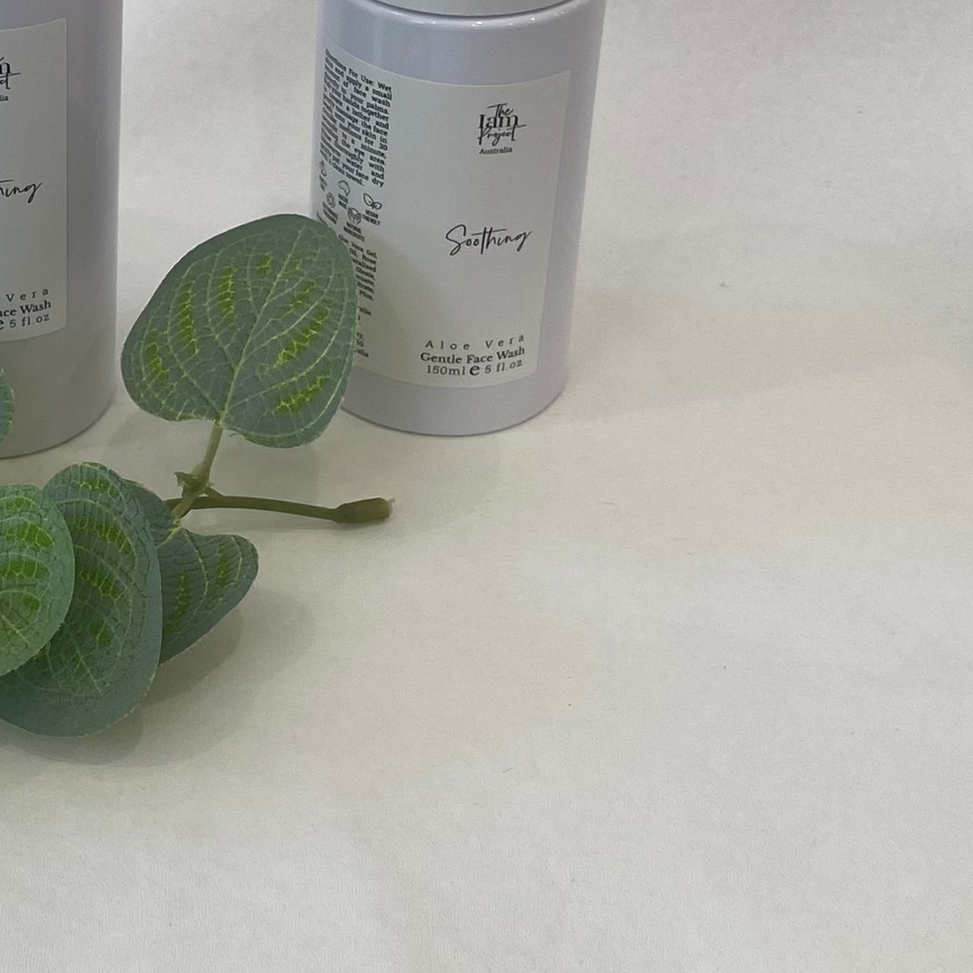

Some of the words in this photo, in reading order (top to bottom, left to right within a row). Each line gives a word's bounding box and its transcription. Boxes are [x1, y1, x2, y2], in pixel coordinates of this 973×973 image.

[487, 103, 514, 118] The
[477, 124, 527, 146] Project
[445, 224, 532, 256] Soothing
[6, 288, 49, 302] Vera
[19, 300, 52, 314] Wash
[9, 319, 17, 328] 5
[425, 340, 470, 350] Aloe
[485, 334, 524, 348] Vera
[420, 352, 462, 364] Gentle
[466, 354, 493, 364] Face
[496, 346, 525, 360] Wash
[426, 365, 465, 375] 150ml
[485, 365, 492, 373] 5
